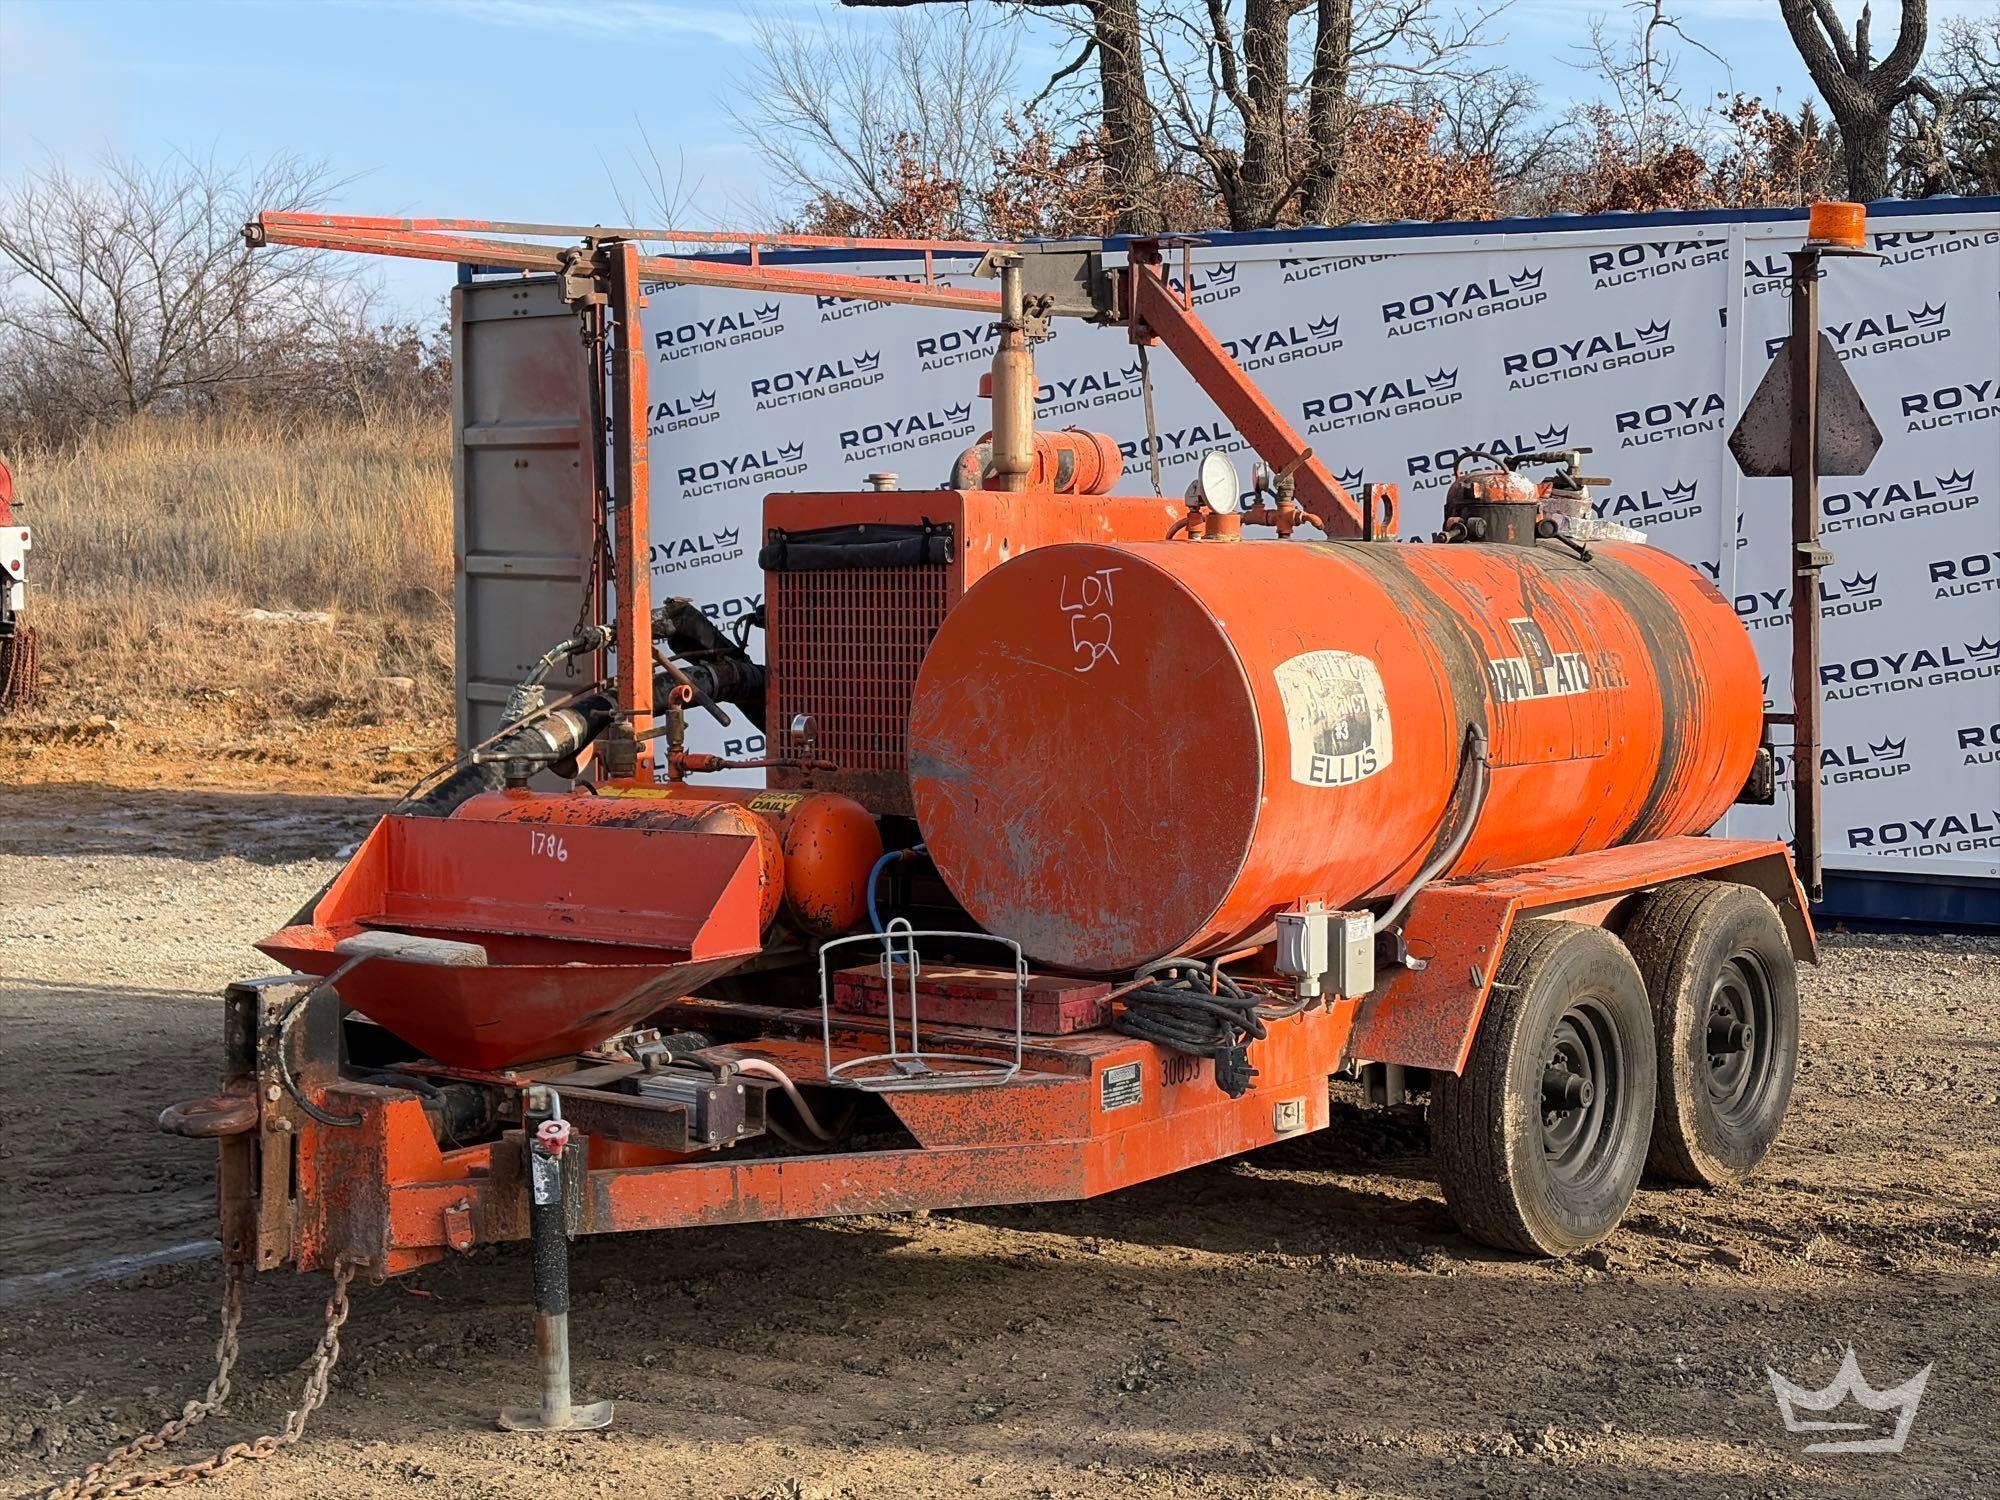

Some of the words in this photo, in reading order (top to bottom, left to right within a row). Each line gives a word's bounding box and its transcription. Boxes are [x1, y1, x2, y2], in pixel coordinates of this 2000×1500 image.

[1879, 236, 1979, 267] AUCTION
[1283, 255, 1366, 284] AUCTION
[1594, 259, 1687, 290] AUCTION
[1191, 286, 1240, 307] ROUP
[1382, 278, 1510, 323] ROYAL
[655, 312, 754, 349] ROYAL
[1387, 309, 1473, 338] AUCTION
[1477, 292, 1548, 317] GROUP
[659, 339, 727, 363] AUCTION
[730, 324, 784, 346] GROUP
[917, 325, 1001, 358] ROYA
[1221, 326, 1308, 359] OYAL
[1278, 339, 1343, 363] GROUP
[1503, 332, 1636, 375] ROYAL
[1873, 329, 1951, 354] GROUP
[921, 346, 994, 372] AUCTION
[1508, 363, 1599, 391] AUCTION
[1603, 345, 1675, 370] GROUP
[751, 360, 854, 397] ROYAL
[755, 387, 825, 411] AUCTION
[829, 373, 884, 394] GROUP
[1034, 371, 1121, 404] OYAL
[1094, 386, 1153, 406] GROU
[1302, 378, 1426, 420] ROYAL
[668, 412, 720, 432] GROUP
[839, 411, 944, 449] ROYAL
[1307, 407, 1391, 435] AUCTION
[1395, 392, 1463, 416] GROUP
[844, 439, 915, 463] AUCTION
[918, 425, 975, 446] GROUP
[1620, 420, 1714, 448] AUCTION
[677, 450, 778, 485] ROYAL
[682, 475, 750, 499] AUCTION
[753, 463, 808, 483] GROUP
[1591, 490, 1663, 519] YAL
[1822, 480, 1937, 516] OYAL
[1900, 496, 1980, 519] GROUP
[1630, 506, 1702, 529] GROUP
[650, 536, 714, 562] YAL
[690, 549, 743, 568] GROUP
[1060, 568, 1122, 611] LOT
[1821, 598, 1882, 618] ROUP
[1070, 613, 1120, 672] 52
[1819, 646, 1965, 686] ROYAL
[1824, 676, 1923, 701] AUCTION
[1309, 748, 1377, 784] ELLIS
[1833, 763, 1911, 784] GROUP
[750, 801, 793, 811] DAILY
[530, 830, 568, 862] 1786
[1847, 813, 1993, 848] ROYAL
[1161, 1057, 1200, 1088] 30053
